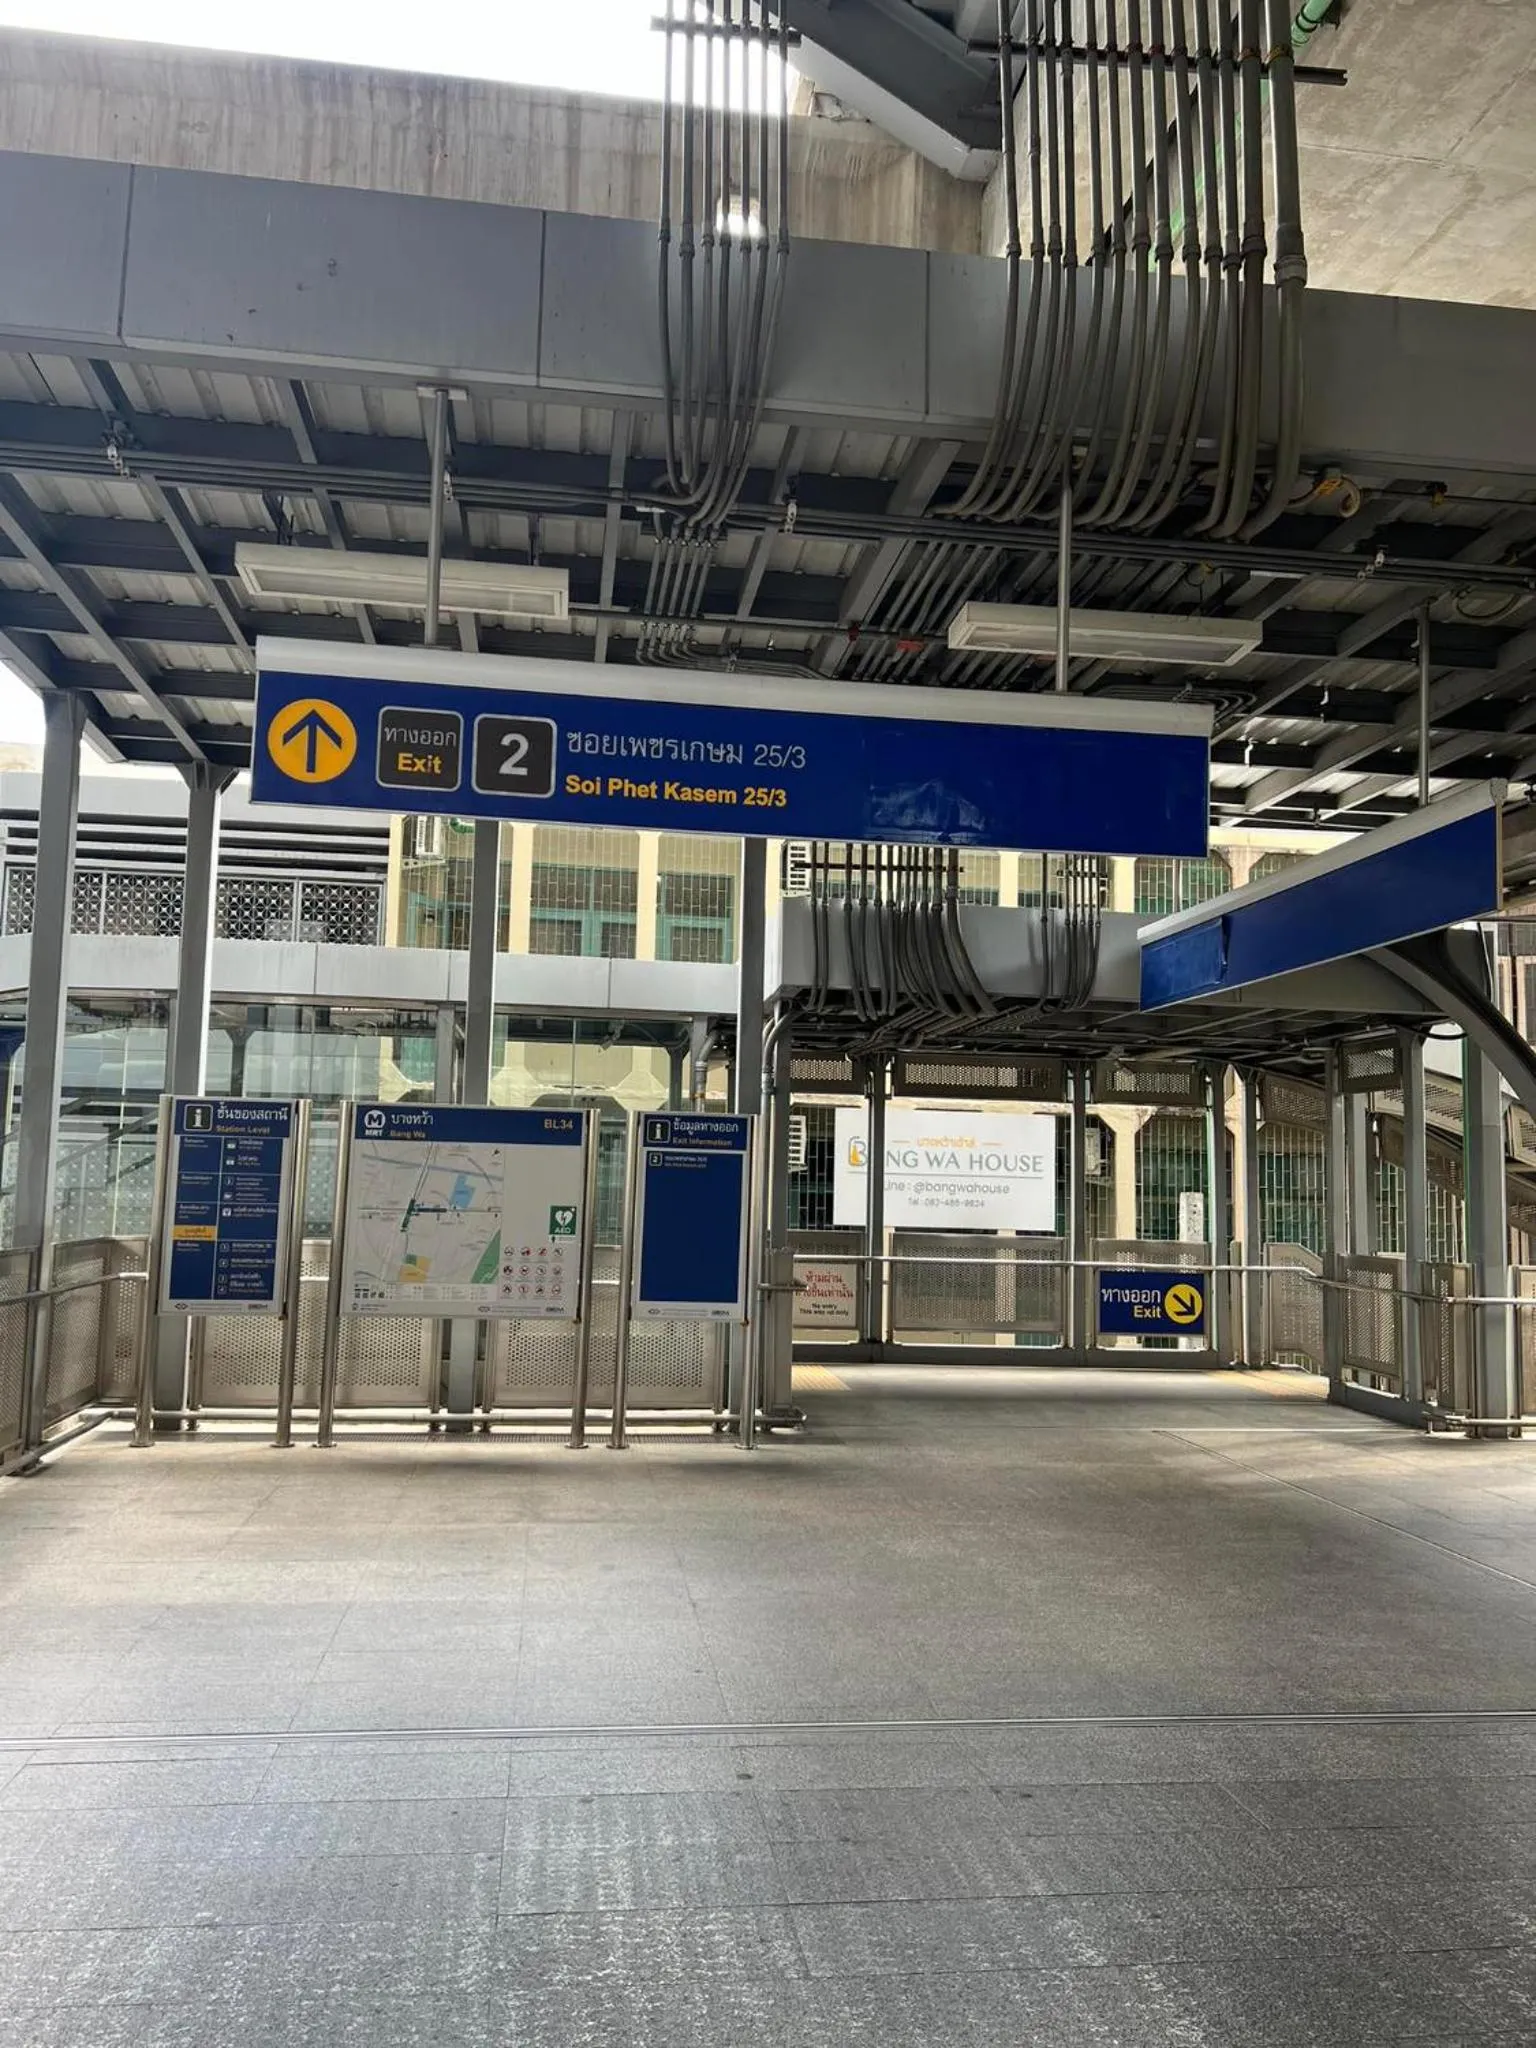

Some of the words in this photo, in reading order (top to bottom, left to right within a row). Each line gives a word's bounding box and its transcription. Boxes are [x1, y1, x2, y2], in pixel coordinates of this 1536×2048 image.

[384, 726, 457, 748] ทางออก
[499, 733, 530, 776] 2
[566, 731, 743, 765] ซอยเพชรเกษม
[753, 744, 806, 769] 25/3
[397, 752, 442, 774] Exit
[565, 774, 601, 795] Soi
[608, 777, 658, 800] Phet
[664, 782, 737, 804] Kasem
[743, 787, 787, 807] 25/3
[217, 1101, 289, 1120] ชั้นของสถานี
[391, 1110, 434, 1125] บางหว้า
[543, 1118, 573, 1129] BL34
[673, 1117, 739, 1135] ข้อมูลทางออก
[848, 1137, 919, 1168] BNG
[926, 1151, 960, 1169] WA
[969, 1153, 1044, 1173] HOUSE
[913, 1182, 1010, 1196] @bangwahouse
[1101, 1288, 1161, 1303] ทางออก
[1133, 1305, 1161, 1318] Exit
